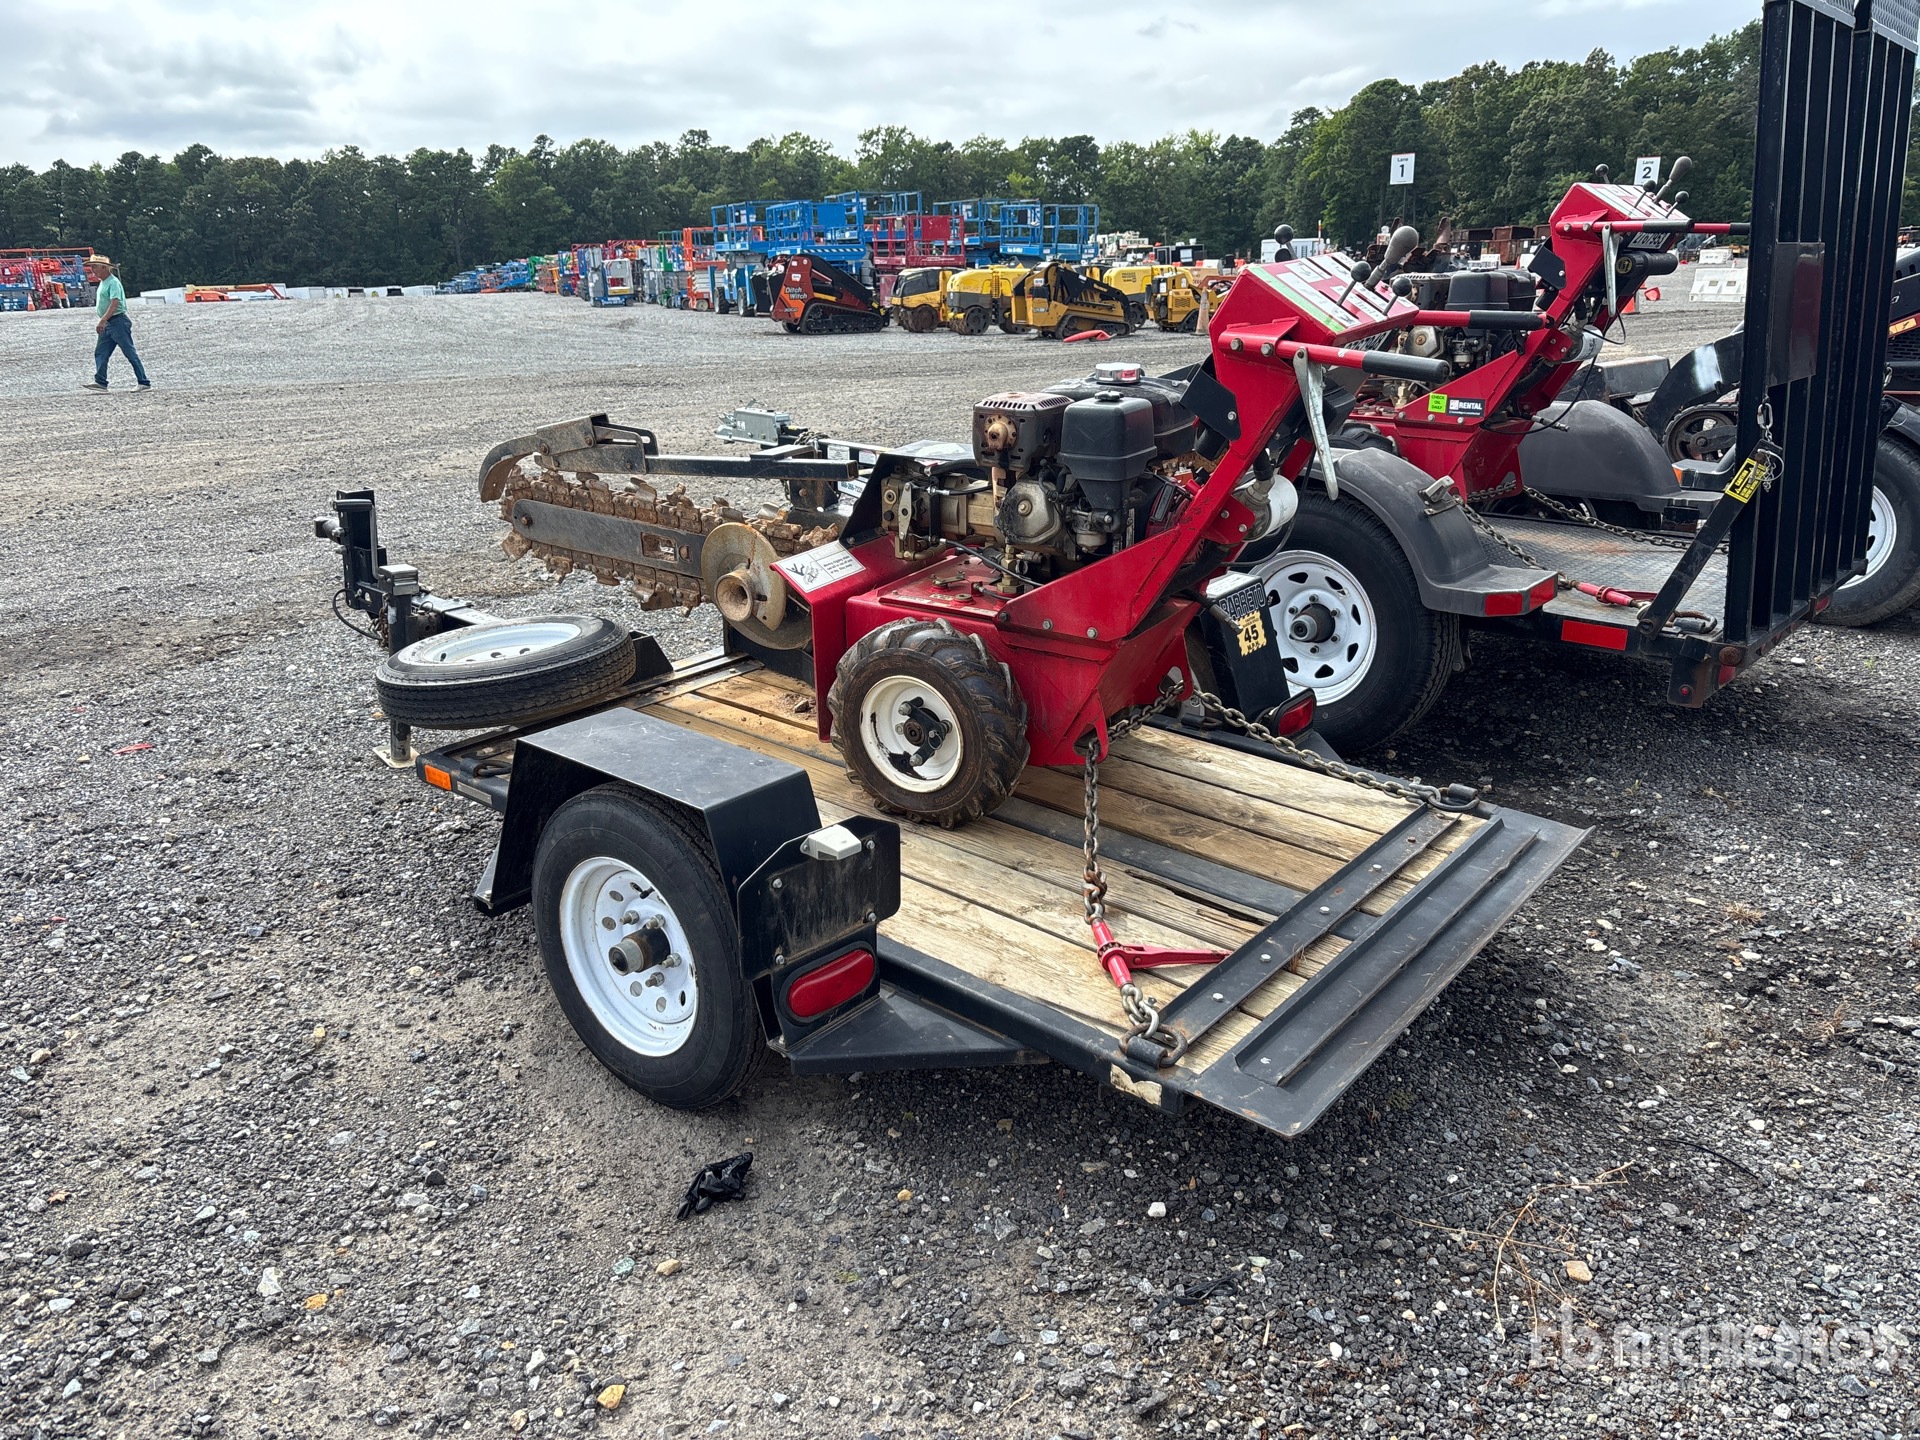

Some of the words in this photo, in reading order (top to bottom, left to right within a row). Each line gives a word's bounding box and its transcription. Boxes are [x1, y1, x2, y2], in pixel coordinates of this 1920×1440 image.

[1399, 164, 1404, 178] 1
[1642, 166, 1652, 179] 2
[1458, 402, 1482, 410] RENTAL
[1219, 582, 1266, 620] BARRETO
[1244, 624, 1259, 643] 45
